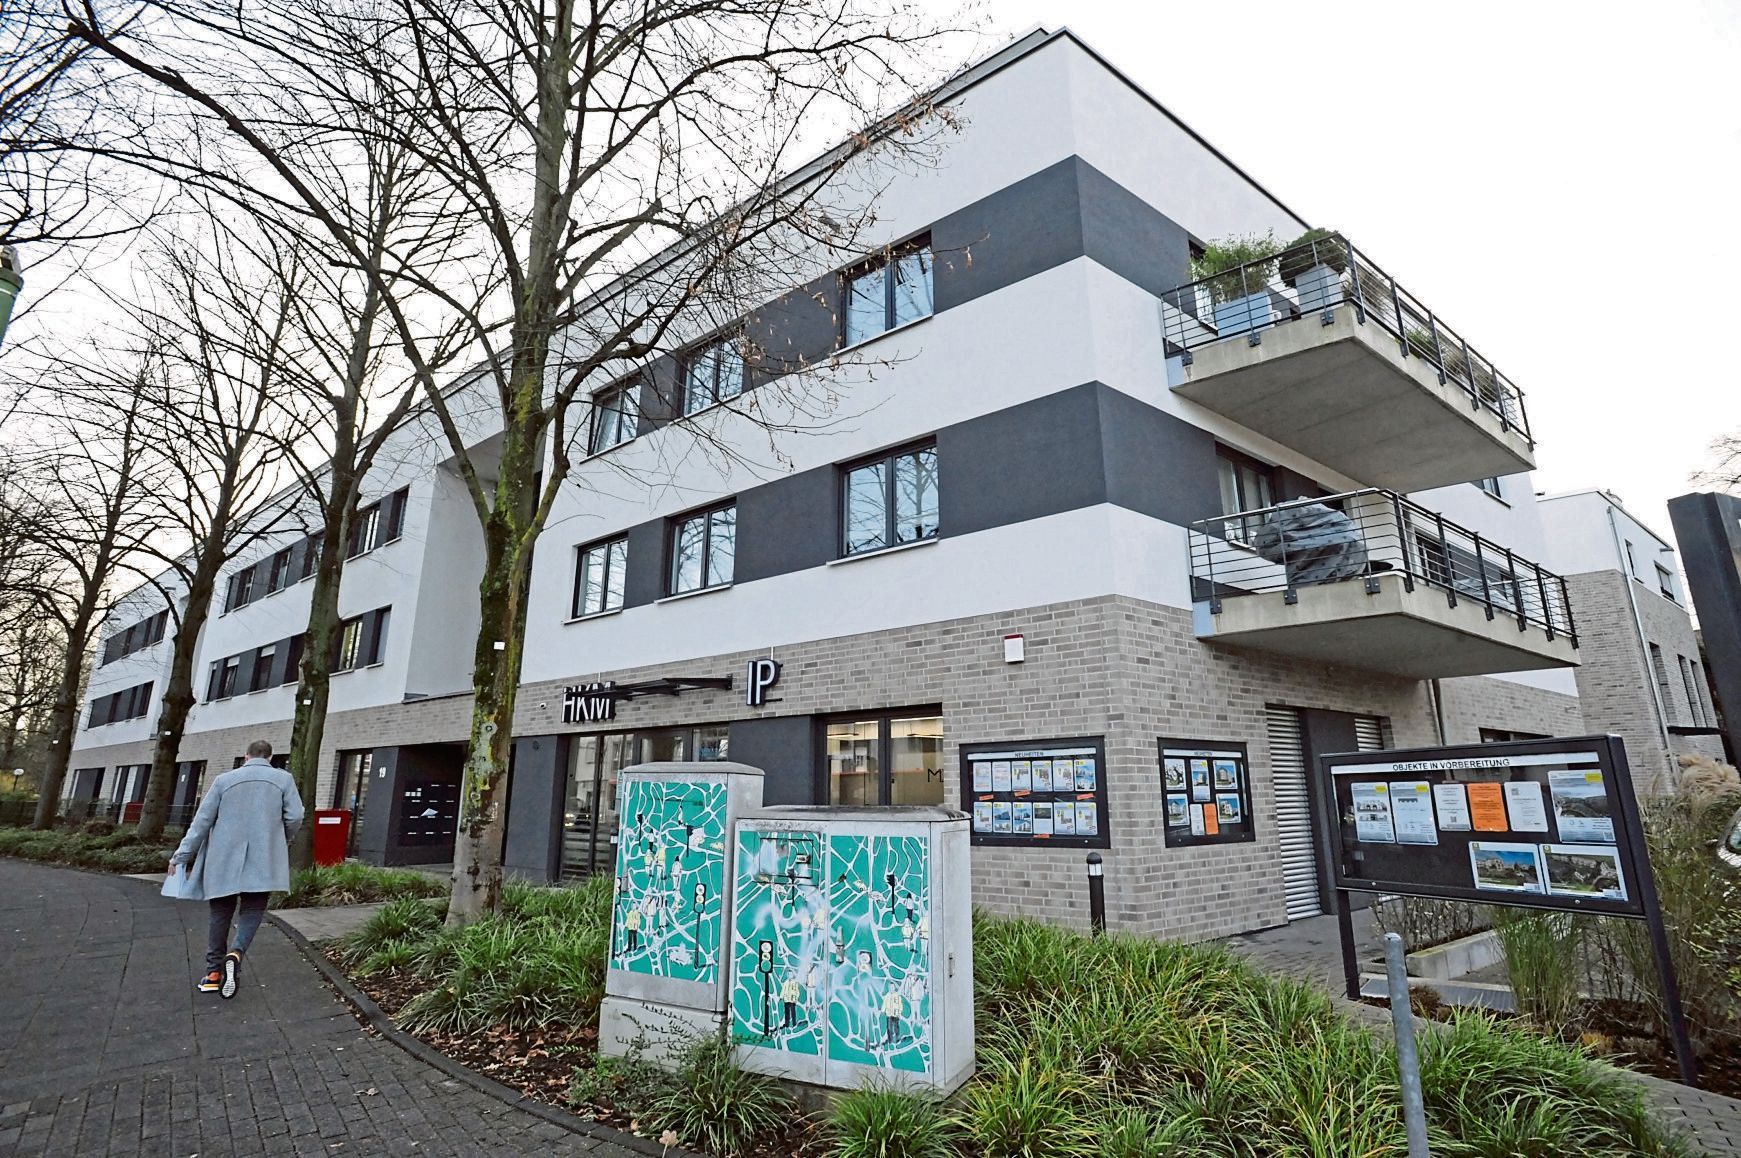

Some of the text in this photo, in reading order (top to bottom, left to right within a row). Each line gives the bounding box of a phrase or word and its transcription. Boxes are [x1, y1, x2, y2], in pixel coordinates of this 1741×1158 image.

[561, 681, 613, 722] HKM
[747, 660, 777, 705] IP
[1392, 763, 1428, 772] OBJEKTE
[1439, 759, 1510, 769] VORBEREITUNG
